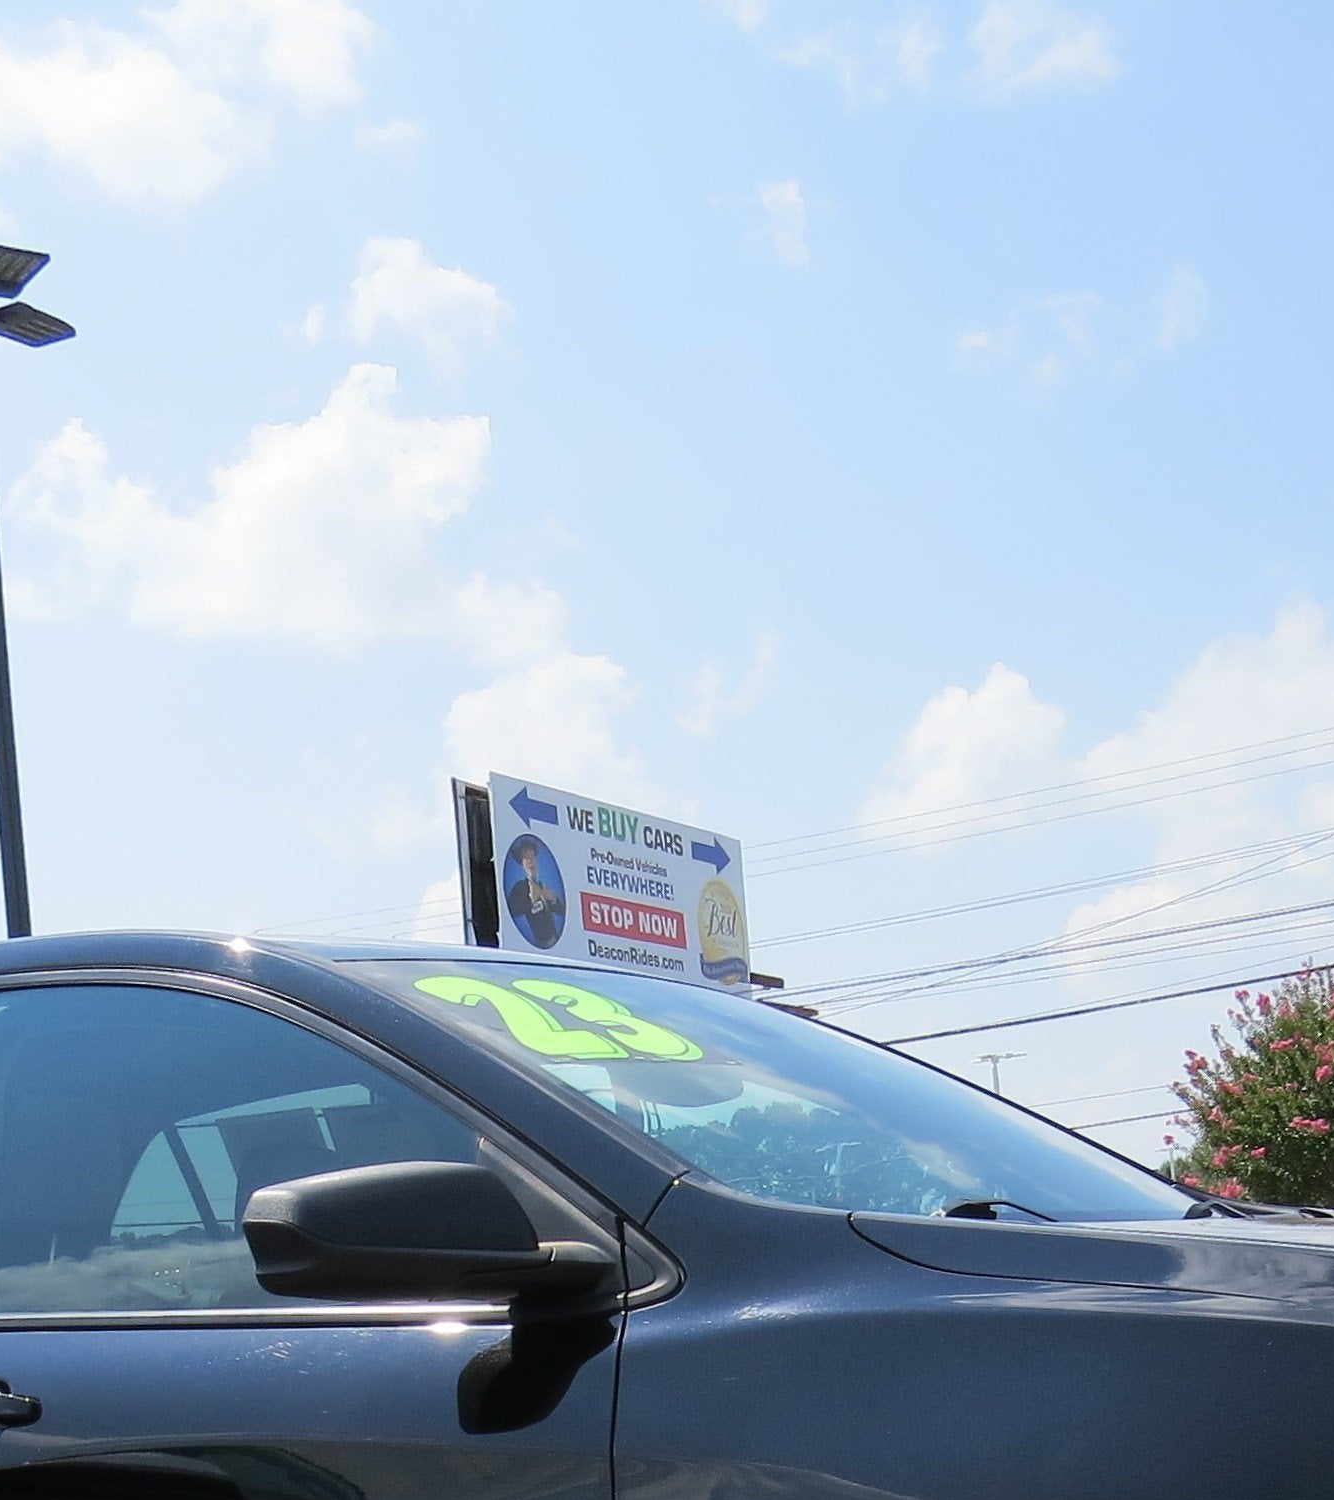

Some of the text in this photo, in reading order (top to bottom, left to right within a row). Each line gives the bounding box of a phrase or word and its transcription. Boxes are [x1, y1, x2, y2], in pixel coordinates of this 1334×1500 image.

[566, 805, 684, 857] WE BUY CARS
[586, 866, 675, 902] EVERYWHERE!
[590, 901, 677, 940] STOP NOW
[587, 939, 685, 973] DeaconRides.com
[413, 976, 705, 1062] 23
